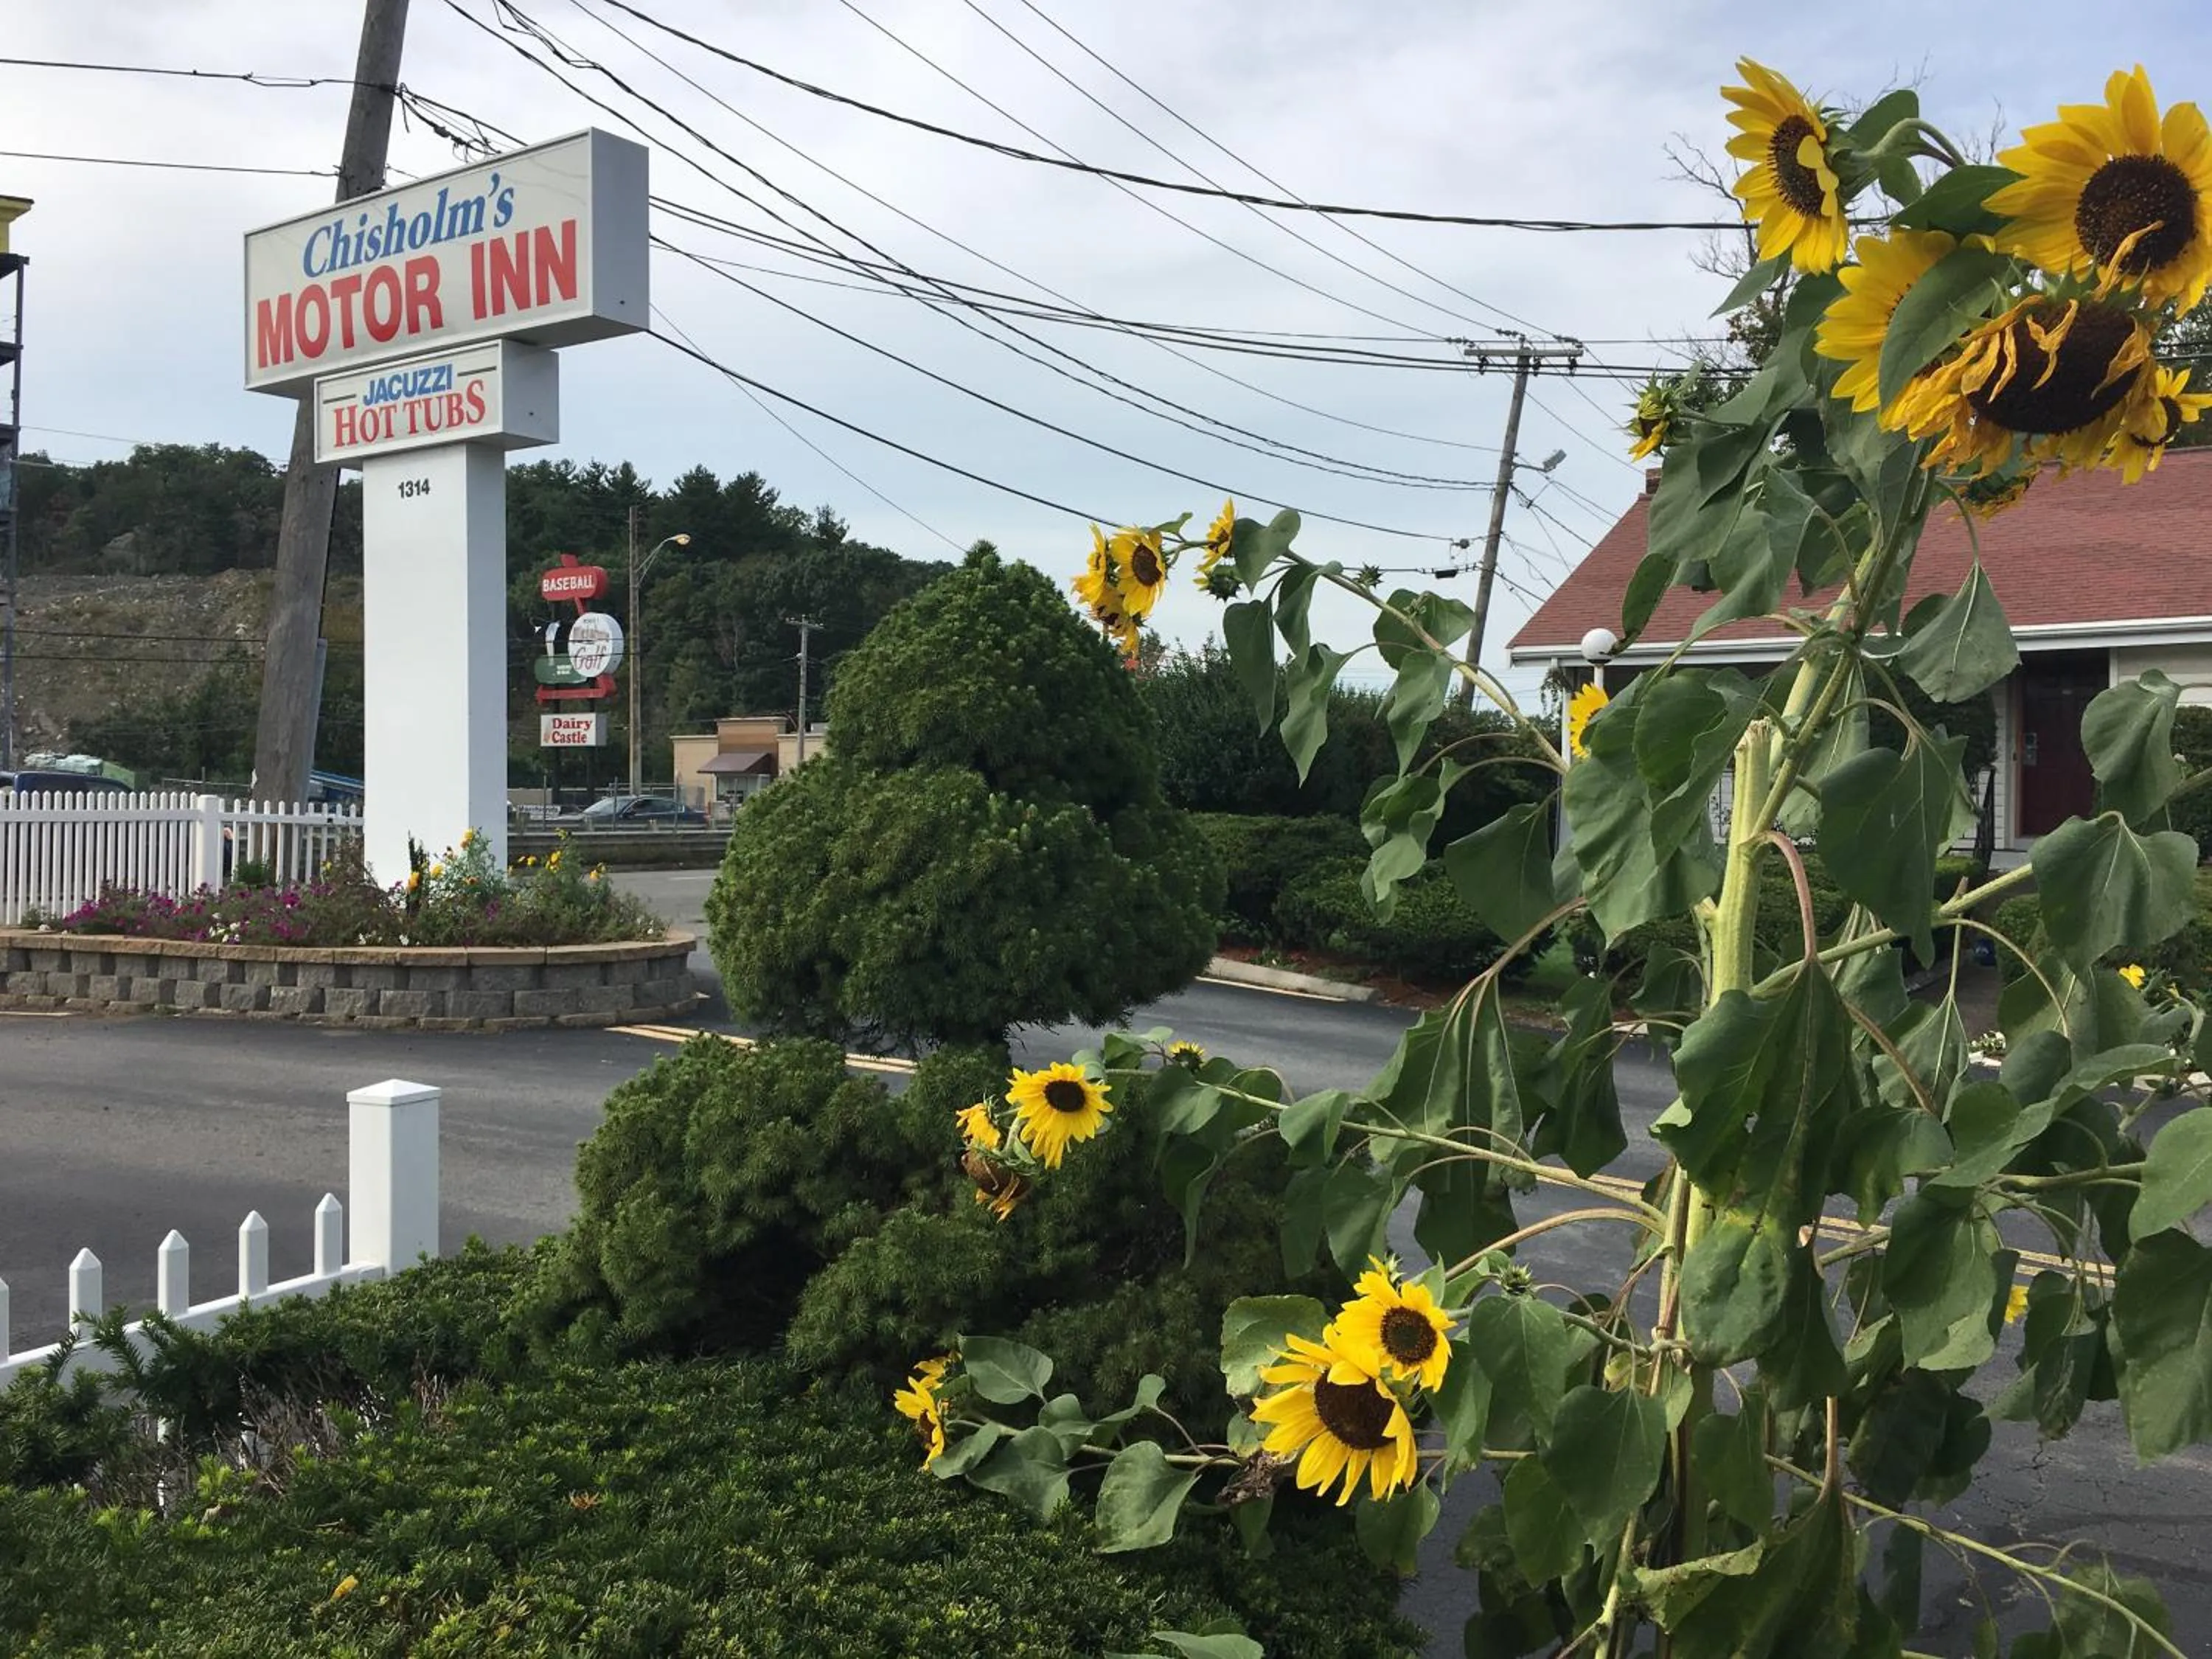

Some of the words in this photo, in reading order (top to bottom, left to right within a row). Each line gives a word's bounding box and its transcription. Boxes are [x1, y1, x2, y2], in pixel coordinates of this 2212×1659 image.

[303, 172, 515, 278] Chisholm's
[257, 255, 444, 369] MOTOR
[470, 219, 577, 321] INN
[363, 364, 453, 406] JACUZZI
[334, 403, 397, 448] HOT
[403, 379, 486, 434] TUBS
[398, 479, 431, 498] 1314
[542, 575, 595, 592] BASEBALL
[574, 645, 607, 670] Golf
[552, 718, 592, 731] Dairy
[552, 731, 588, 744] Castle
